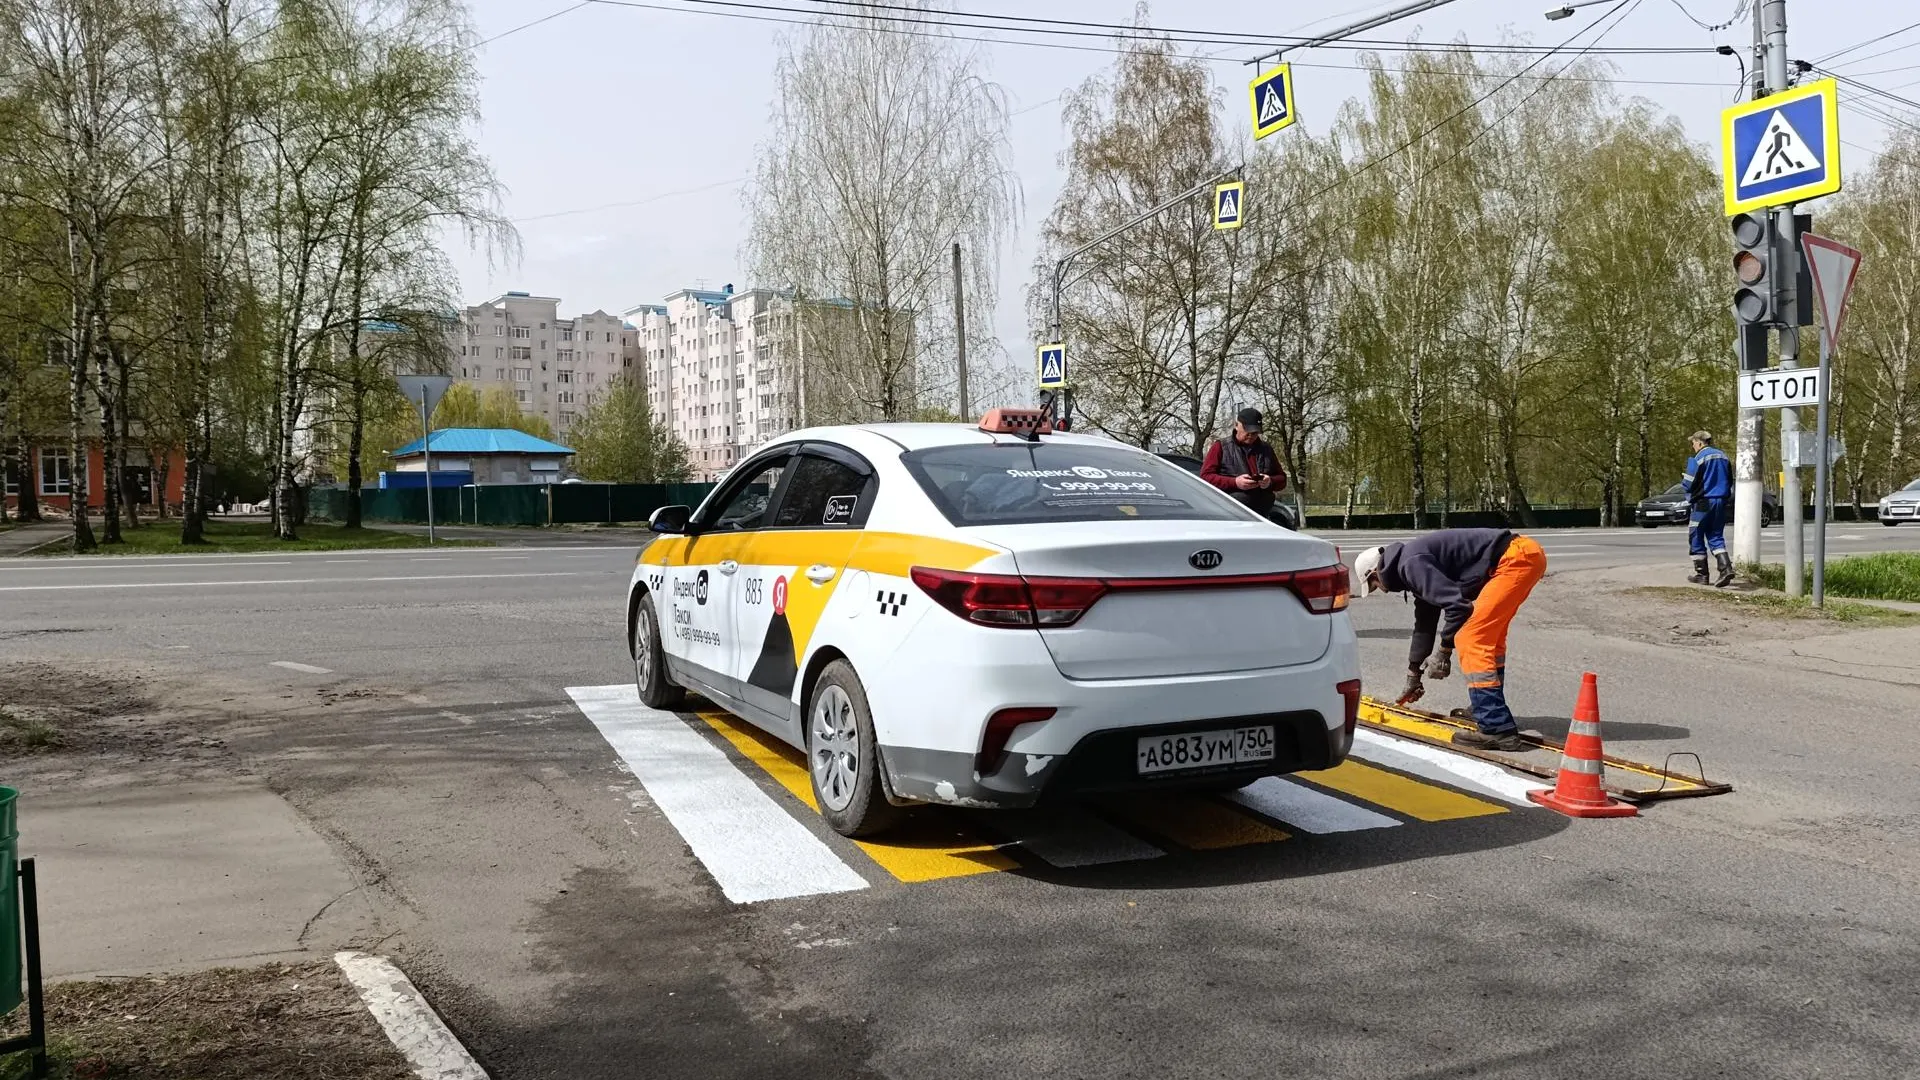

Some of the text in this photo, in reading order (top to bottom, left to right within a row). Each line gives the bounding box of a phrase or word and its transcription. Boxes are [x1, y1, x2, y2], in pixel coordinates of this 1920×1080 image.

[1751, 376, 1816, 401] СТОП
[1006, 468, 1075, 478] Яндекс
[1102, 468, 1152, 478] Такси
[1060, 482, 1156, 491] 999-99-99
[1196, 553, 1220, 566] KIA
[673, 577, 696, 599] Яндекс
[745, 577, 763, 605] 883
[775, 582, 785, 609] Я
[673, 603, 692, 625] Такси
[679, 626, 721, 646] (495) 999-99-99
[1236, 728, 1268, 750] 750
